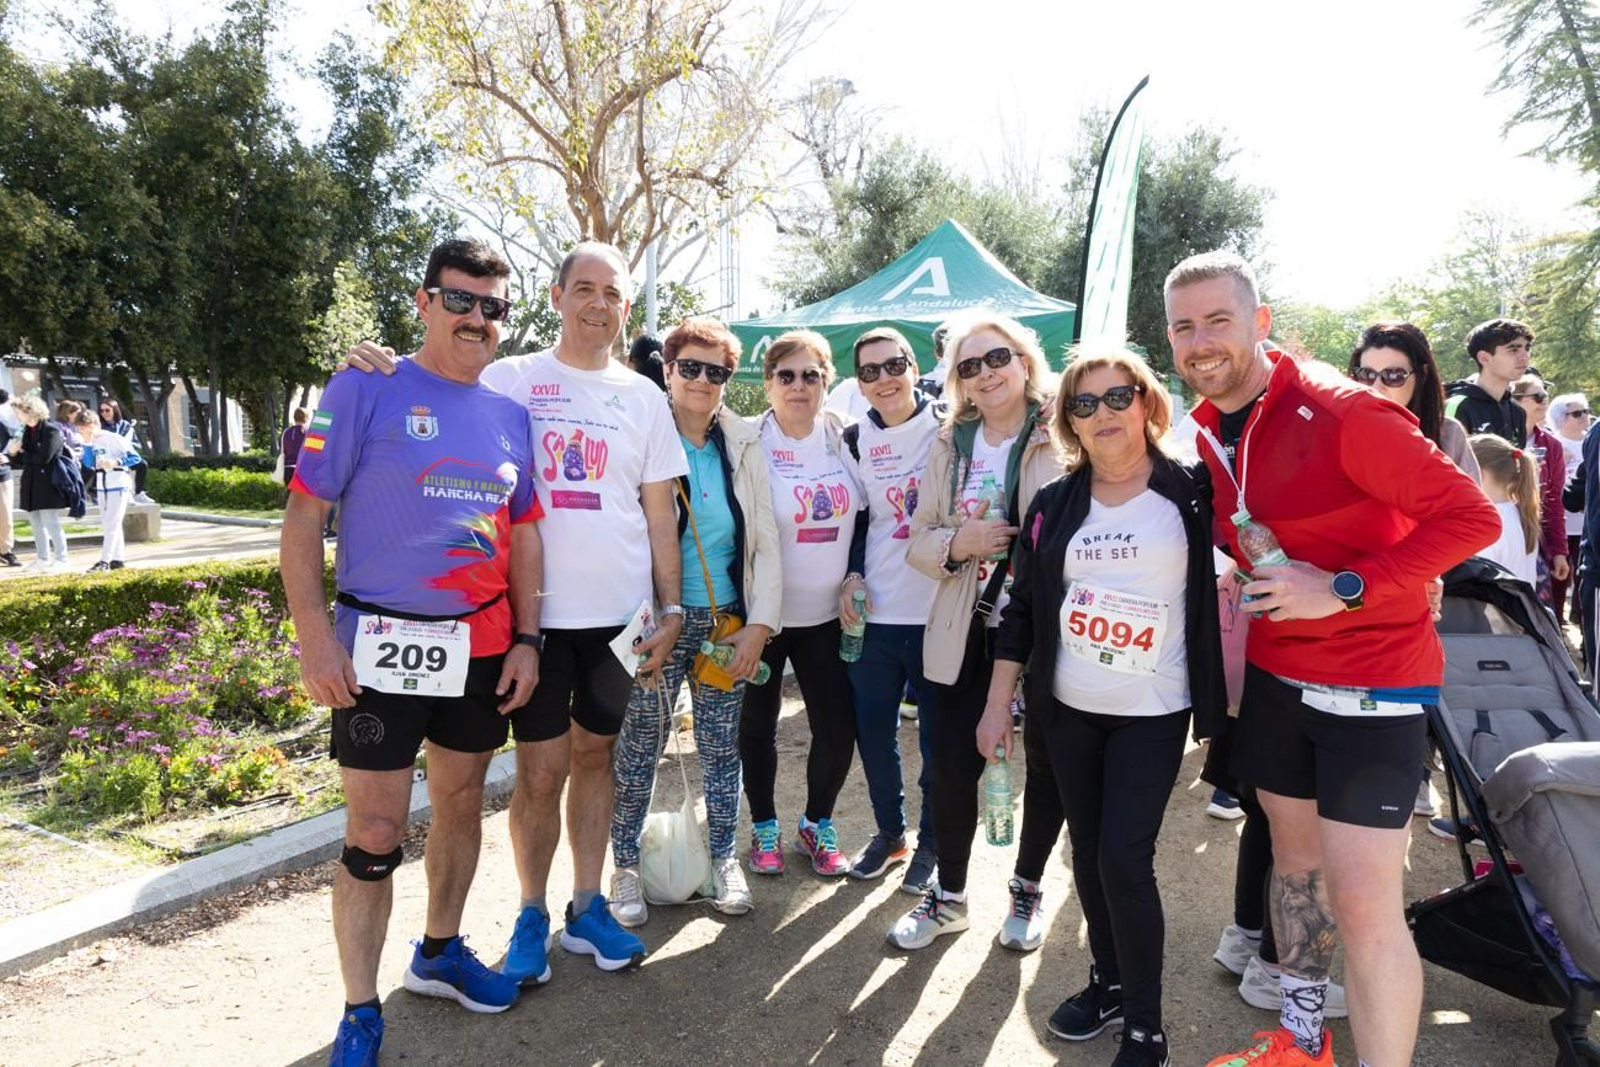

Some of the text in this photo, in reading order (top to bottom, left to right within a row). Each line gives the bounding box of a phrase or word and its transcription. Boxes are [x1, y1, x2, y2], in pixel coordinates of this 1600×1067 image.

[531, 383, 561, 396] XXVII
[423, 474, 472, 490] ATLETISMO
[423, 486, 484, 503] MANCHA
[1083, 532, 1136, 546] BREAK
[1075, 546, 1139, 561] THE SET
[1067, 610, 1155, 652] 5094
[375, 641, 448, 673] 209
